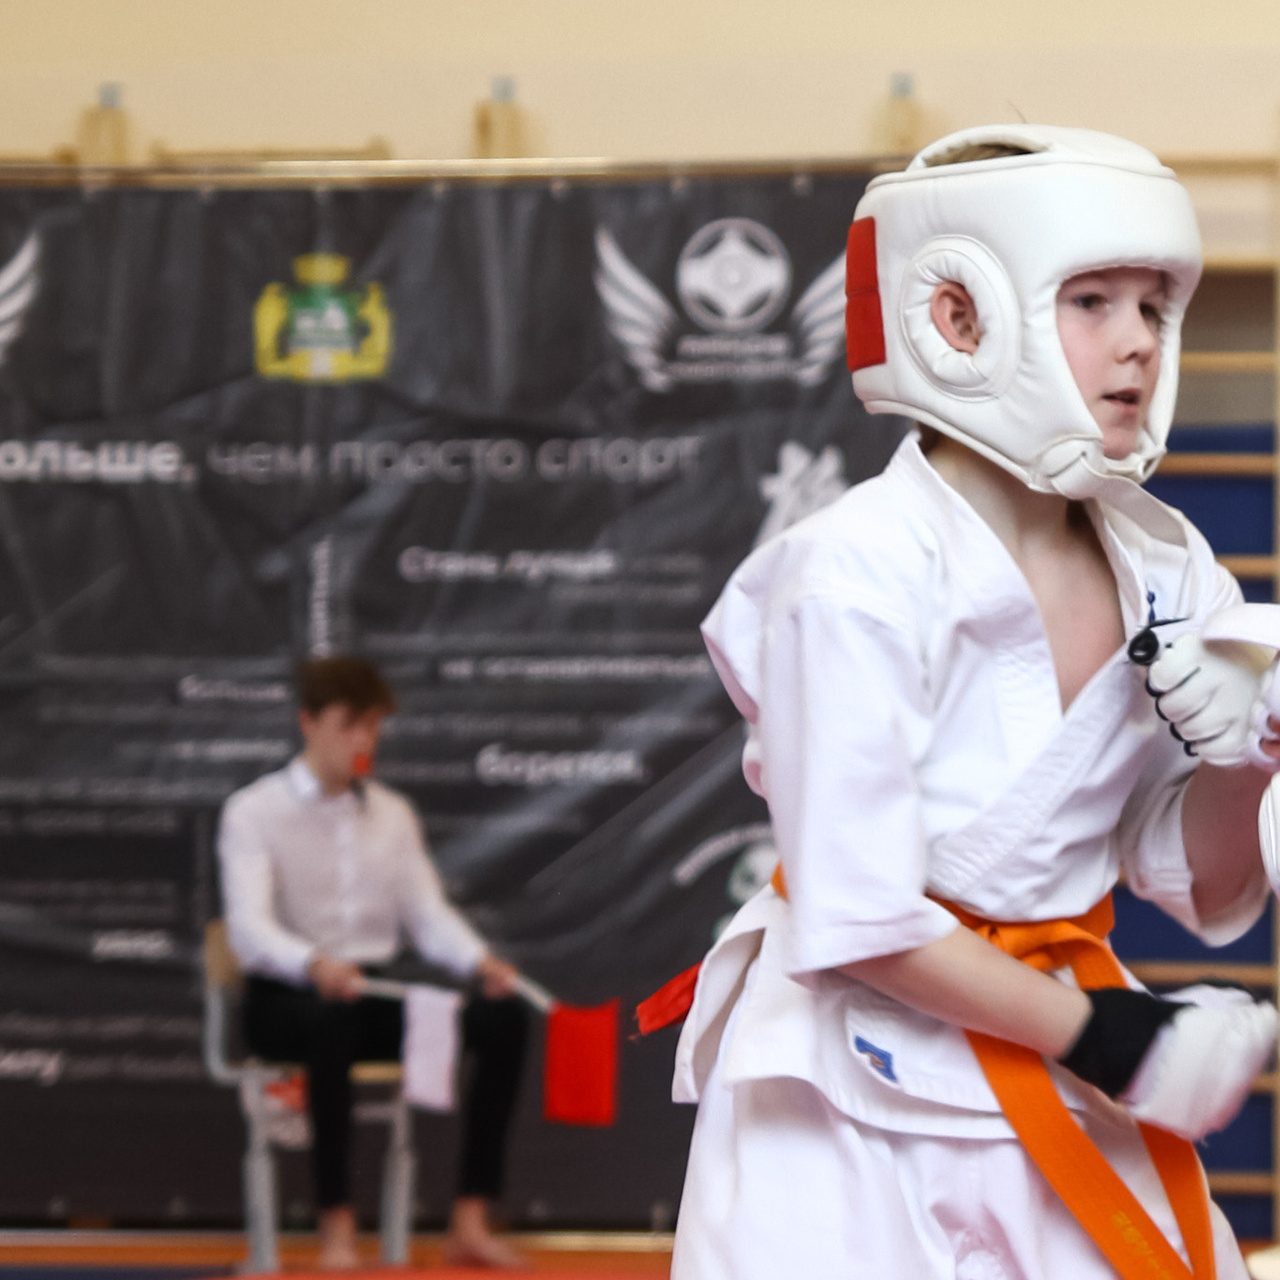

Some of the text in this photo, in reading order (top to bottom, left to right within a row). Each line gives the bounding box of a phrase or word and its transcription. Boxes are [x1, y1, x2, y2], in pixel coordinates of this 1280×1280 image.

[207, 439, 314, 485] чем
[329, 437, 530, 485] просто
[535, 434, 703, 487] спорт
